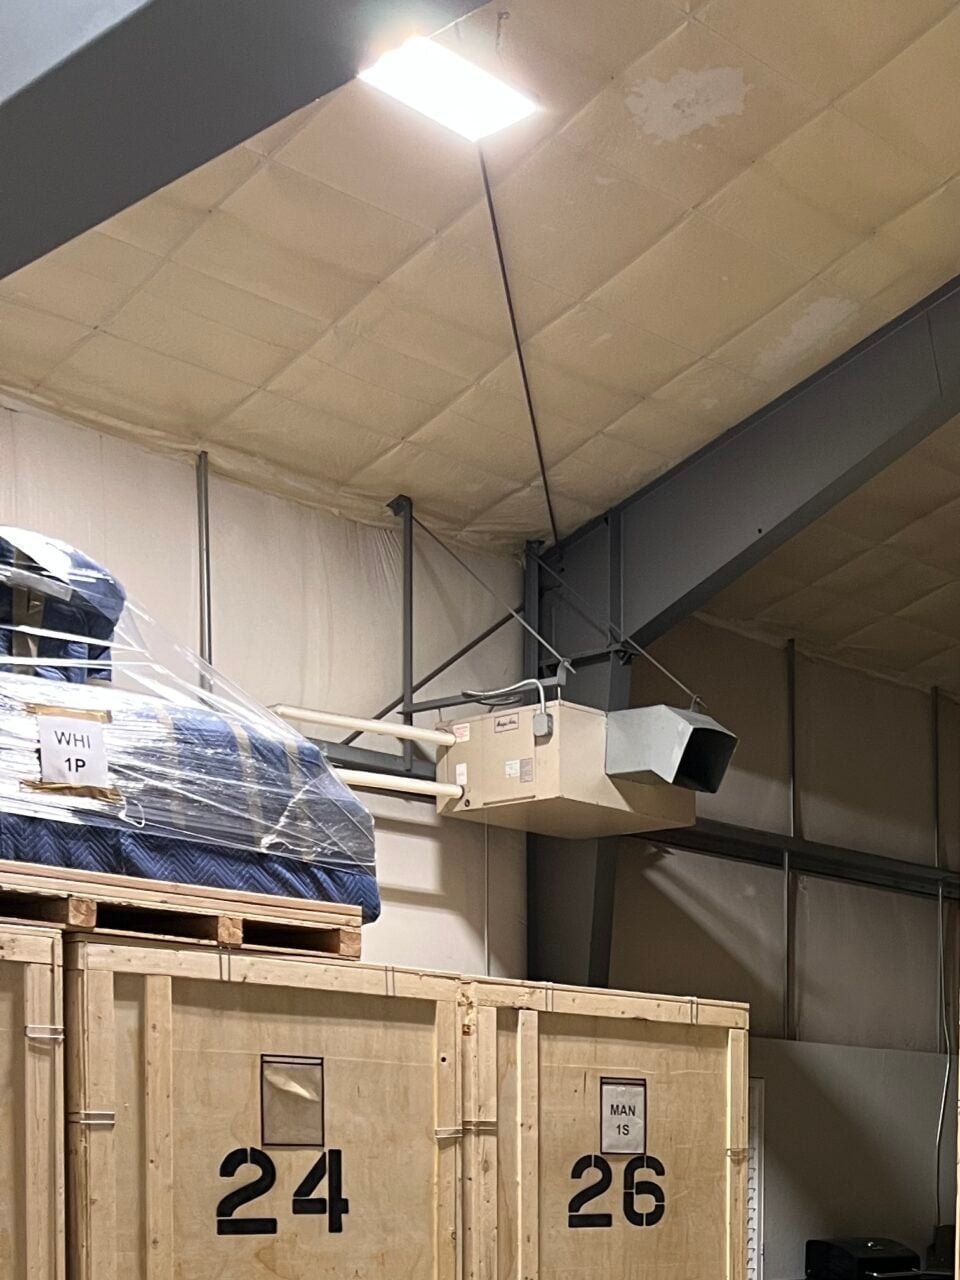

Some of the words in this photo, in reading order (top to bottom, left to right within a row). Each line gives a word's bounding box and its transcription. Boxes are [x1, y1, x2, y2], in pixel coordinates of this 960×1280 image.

[55, 731, 91, 748] WHI
[65, 758, 86, 773] 1P
[611, 1103, 636, 1117] MAN
[616, 1123, 630, 1136] 1S
[216, 1147, 349, 1236] 24
[568, 1155, 666, 1228] 26
